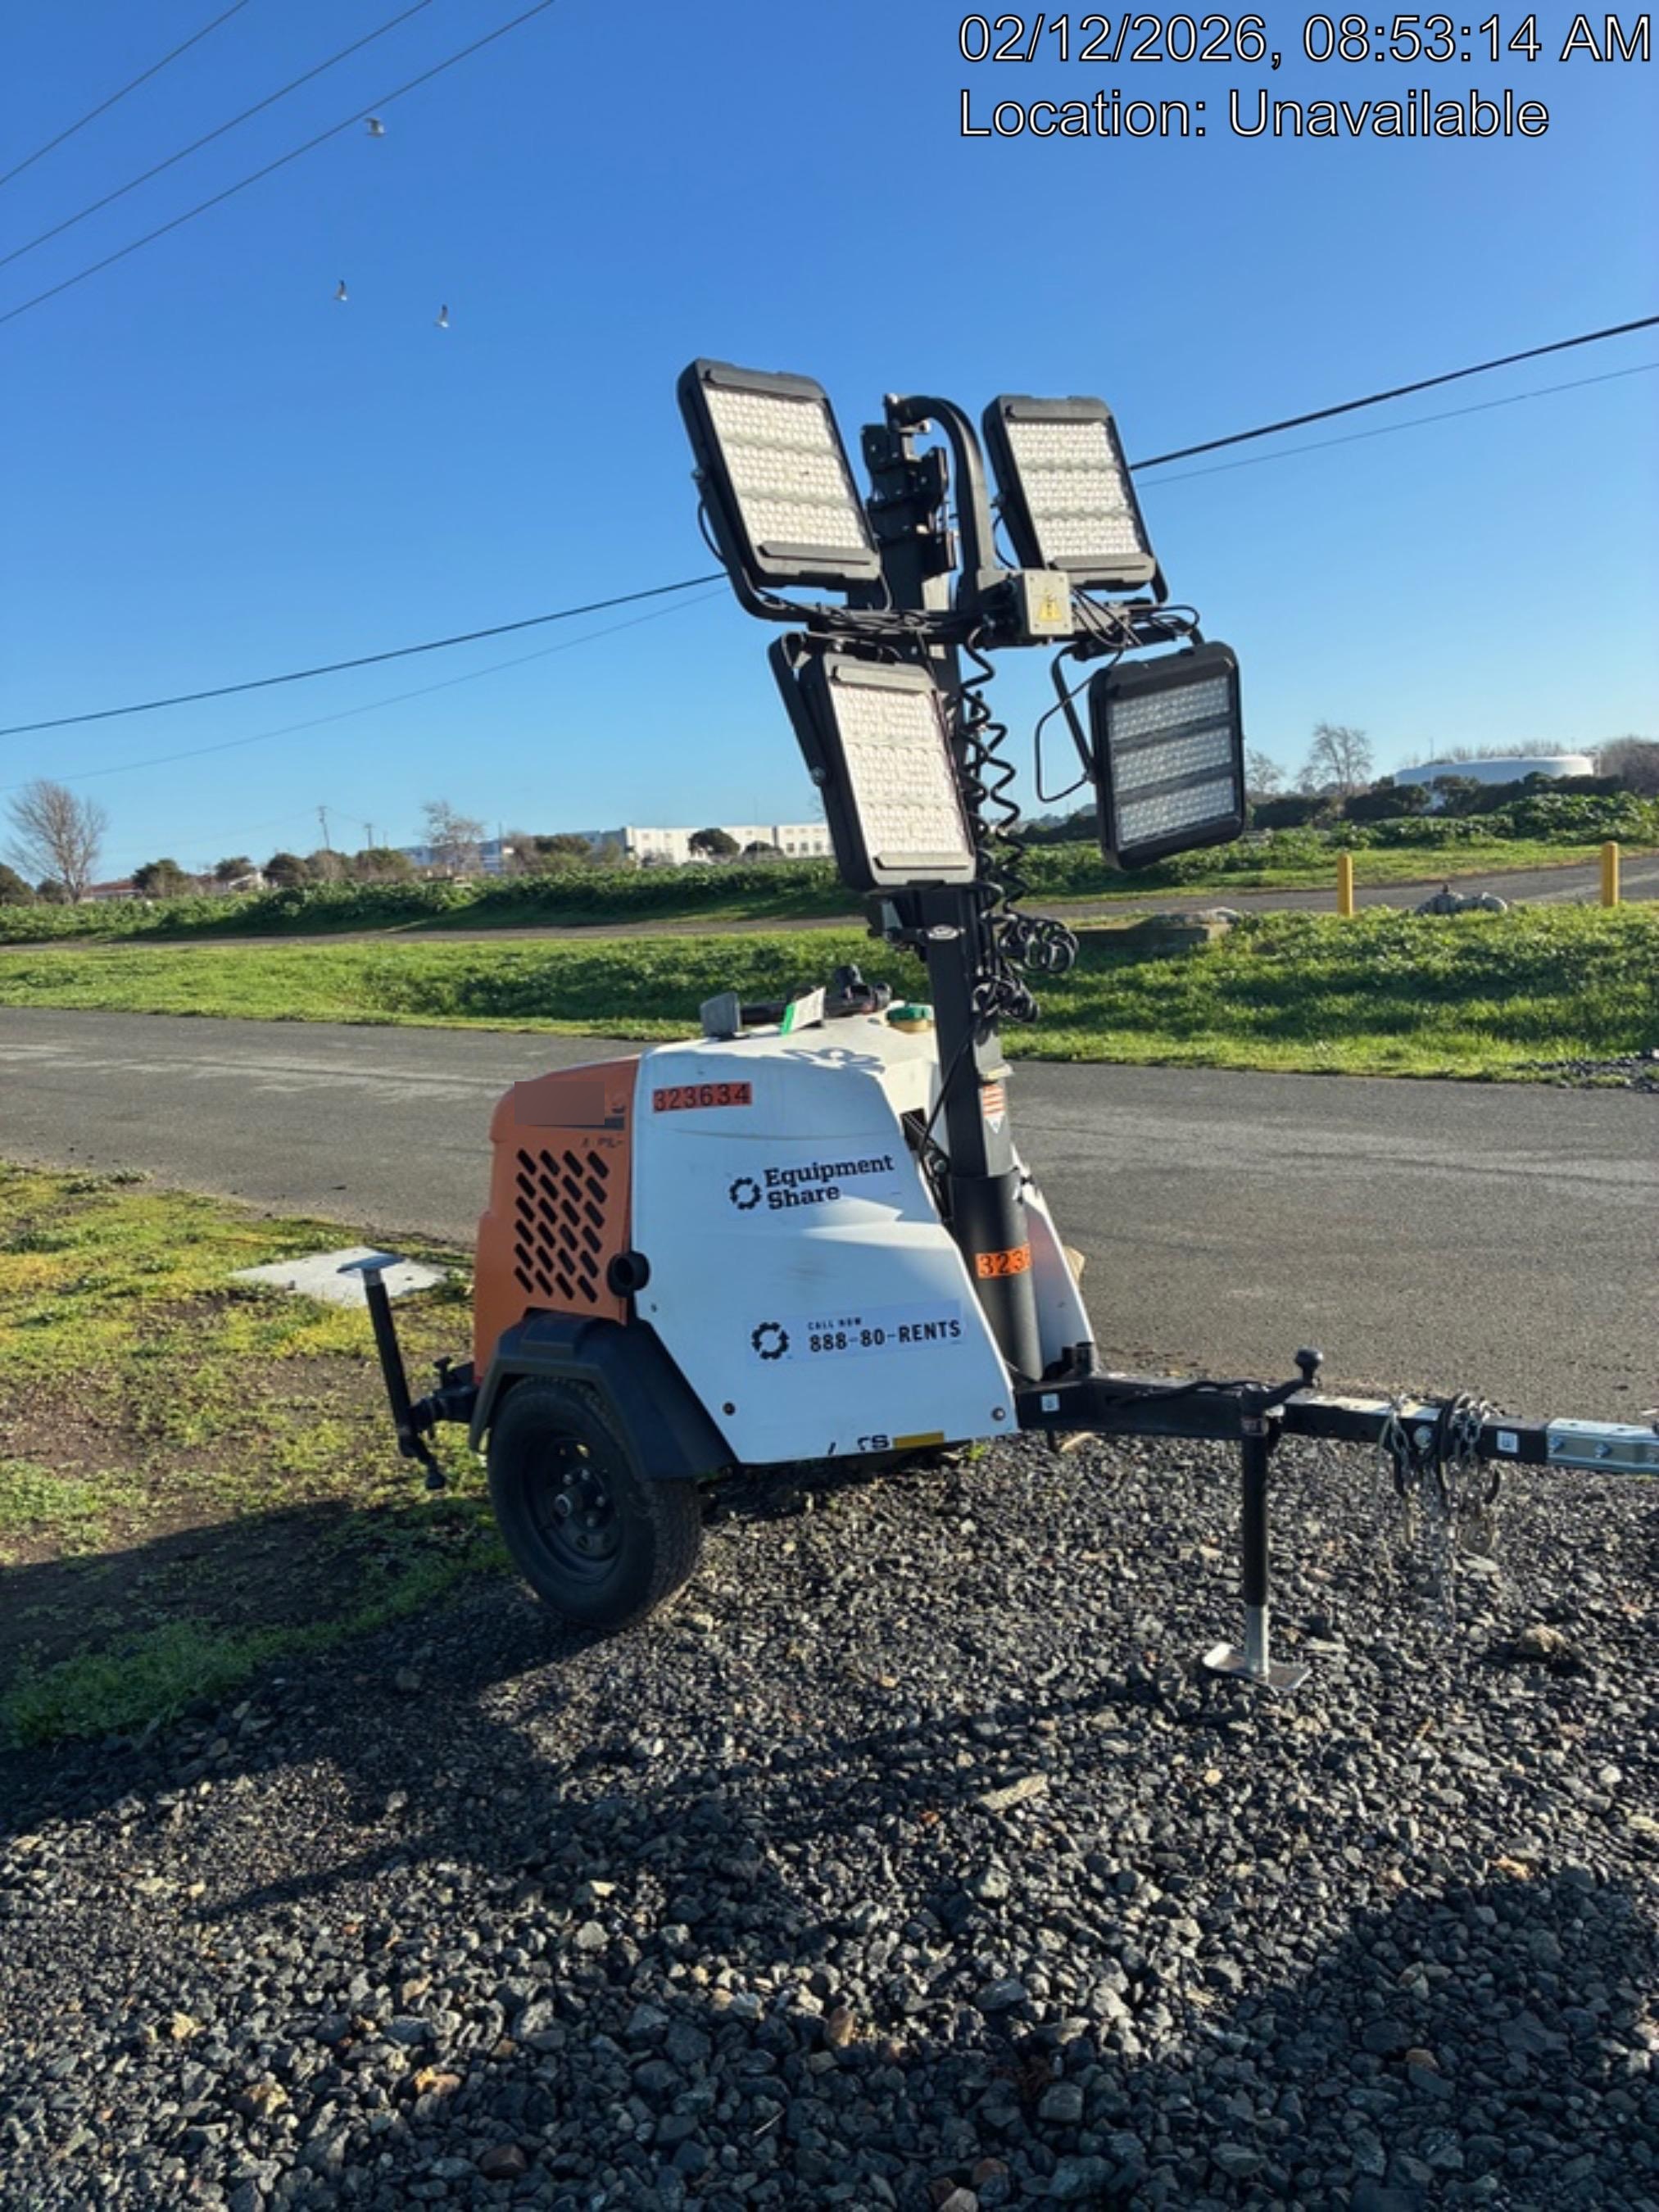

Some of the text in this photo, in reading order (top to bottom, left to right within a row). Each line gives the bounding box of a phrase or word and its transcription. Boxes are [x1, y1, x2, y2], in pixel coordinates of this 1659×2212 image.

[654, 1083, 750, 1112] 323634
[764, 1154, 894, 1188] Equipment
[767, 1186, 840, 1210] Share
[809, 1320, 960, 1353] 888-80-RENTS
